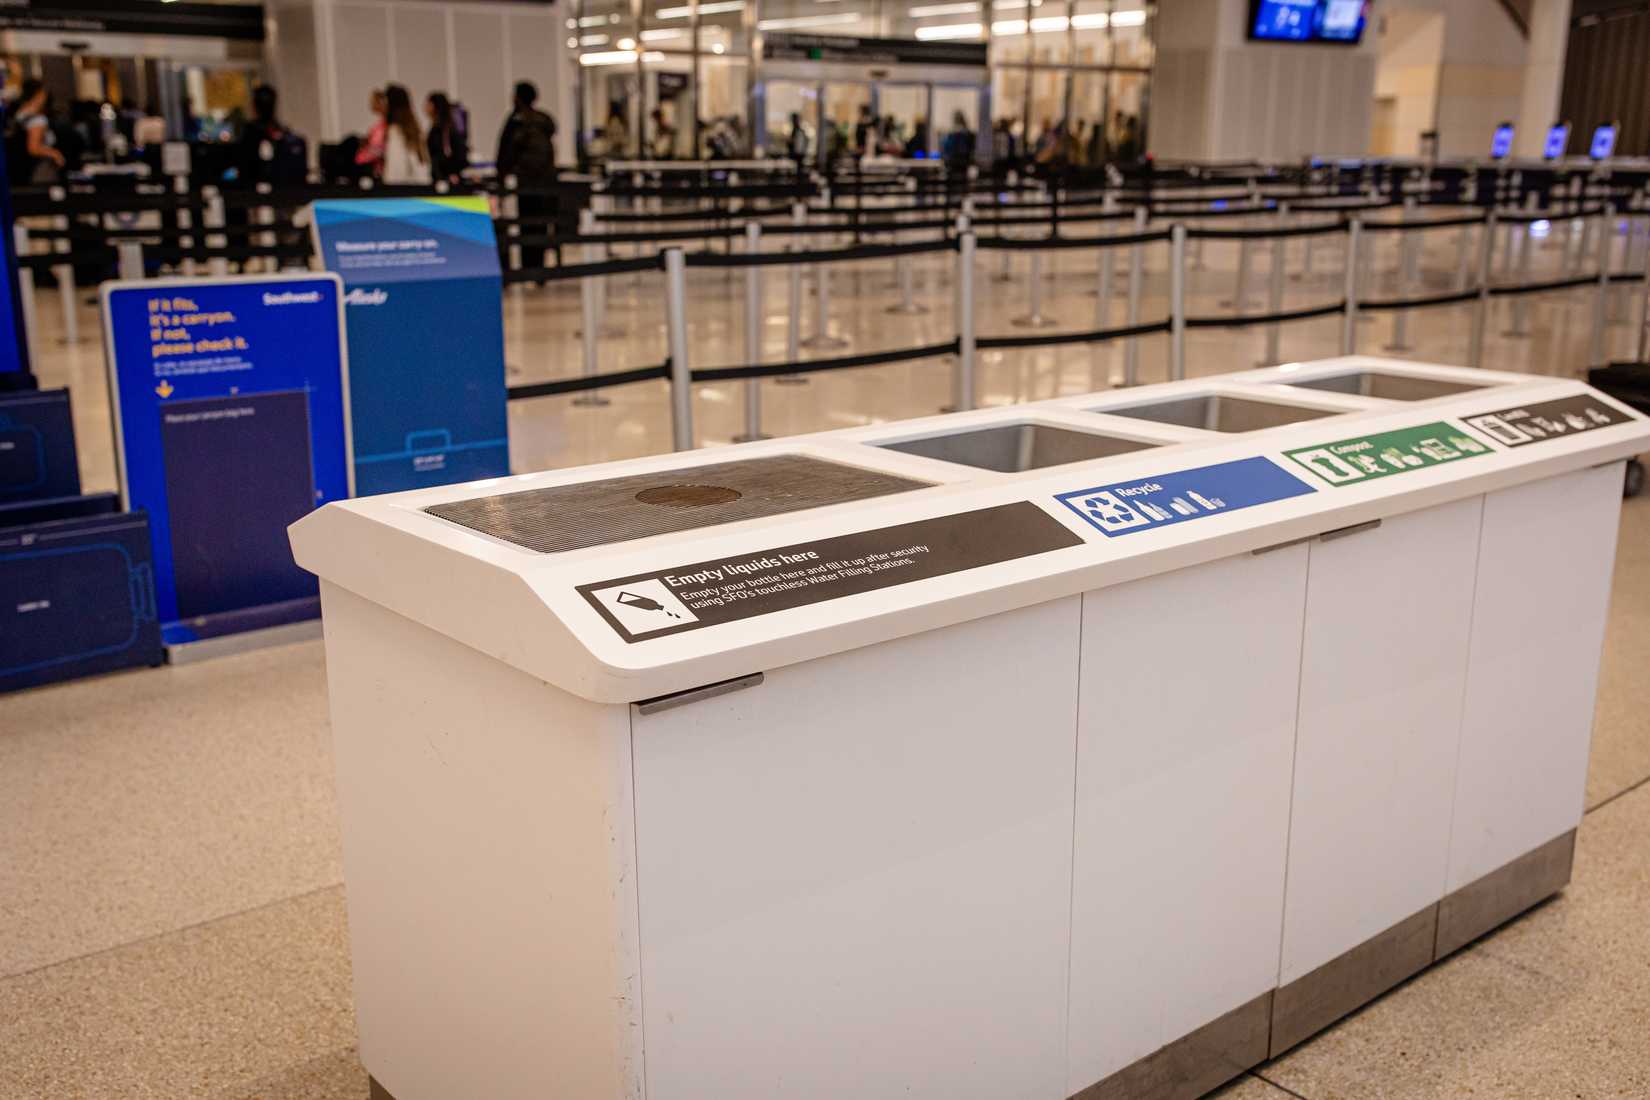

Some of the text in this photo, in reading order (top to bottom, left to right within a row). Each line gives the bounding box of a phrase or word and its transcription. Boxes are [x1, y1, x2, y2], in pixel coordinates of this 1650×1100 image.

[376, 241, 398, 252] your
[171, 315, 181, 326] a
[152, 342, 195, 358] please
[196, 338, 234, 353] check
[1329, 441, 1374, 455] Compost
[1114, 482, 1163, 497] Recycle
[664, 551, 819, 587] Empty liquids here
[680, 544, 930, 601] Empty your bottle here and fill it up after security
[690, 558, 916, 609] using SFO's touchless Water Filling Stations.
